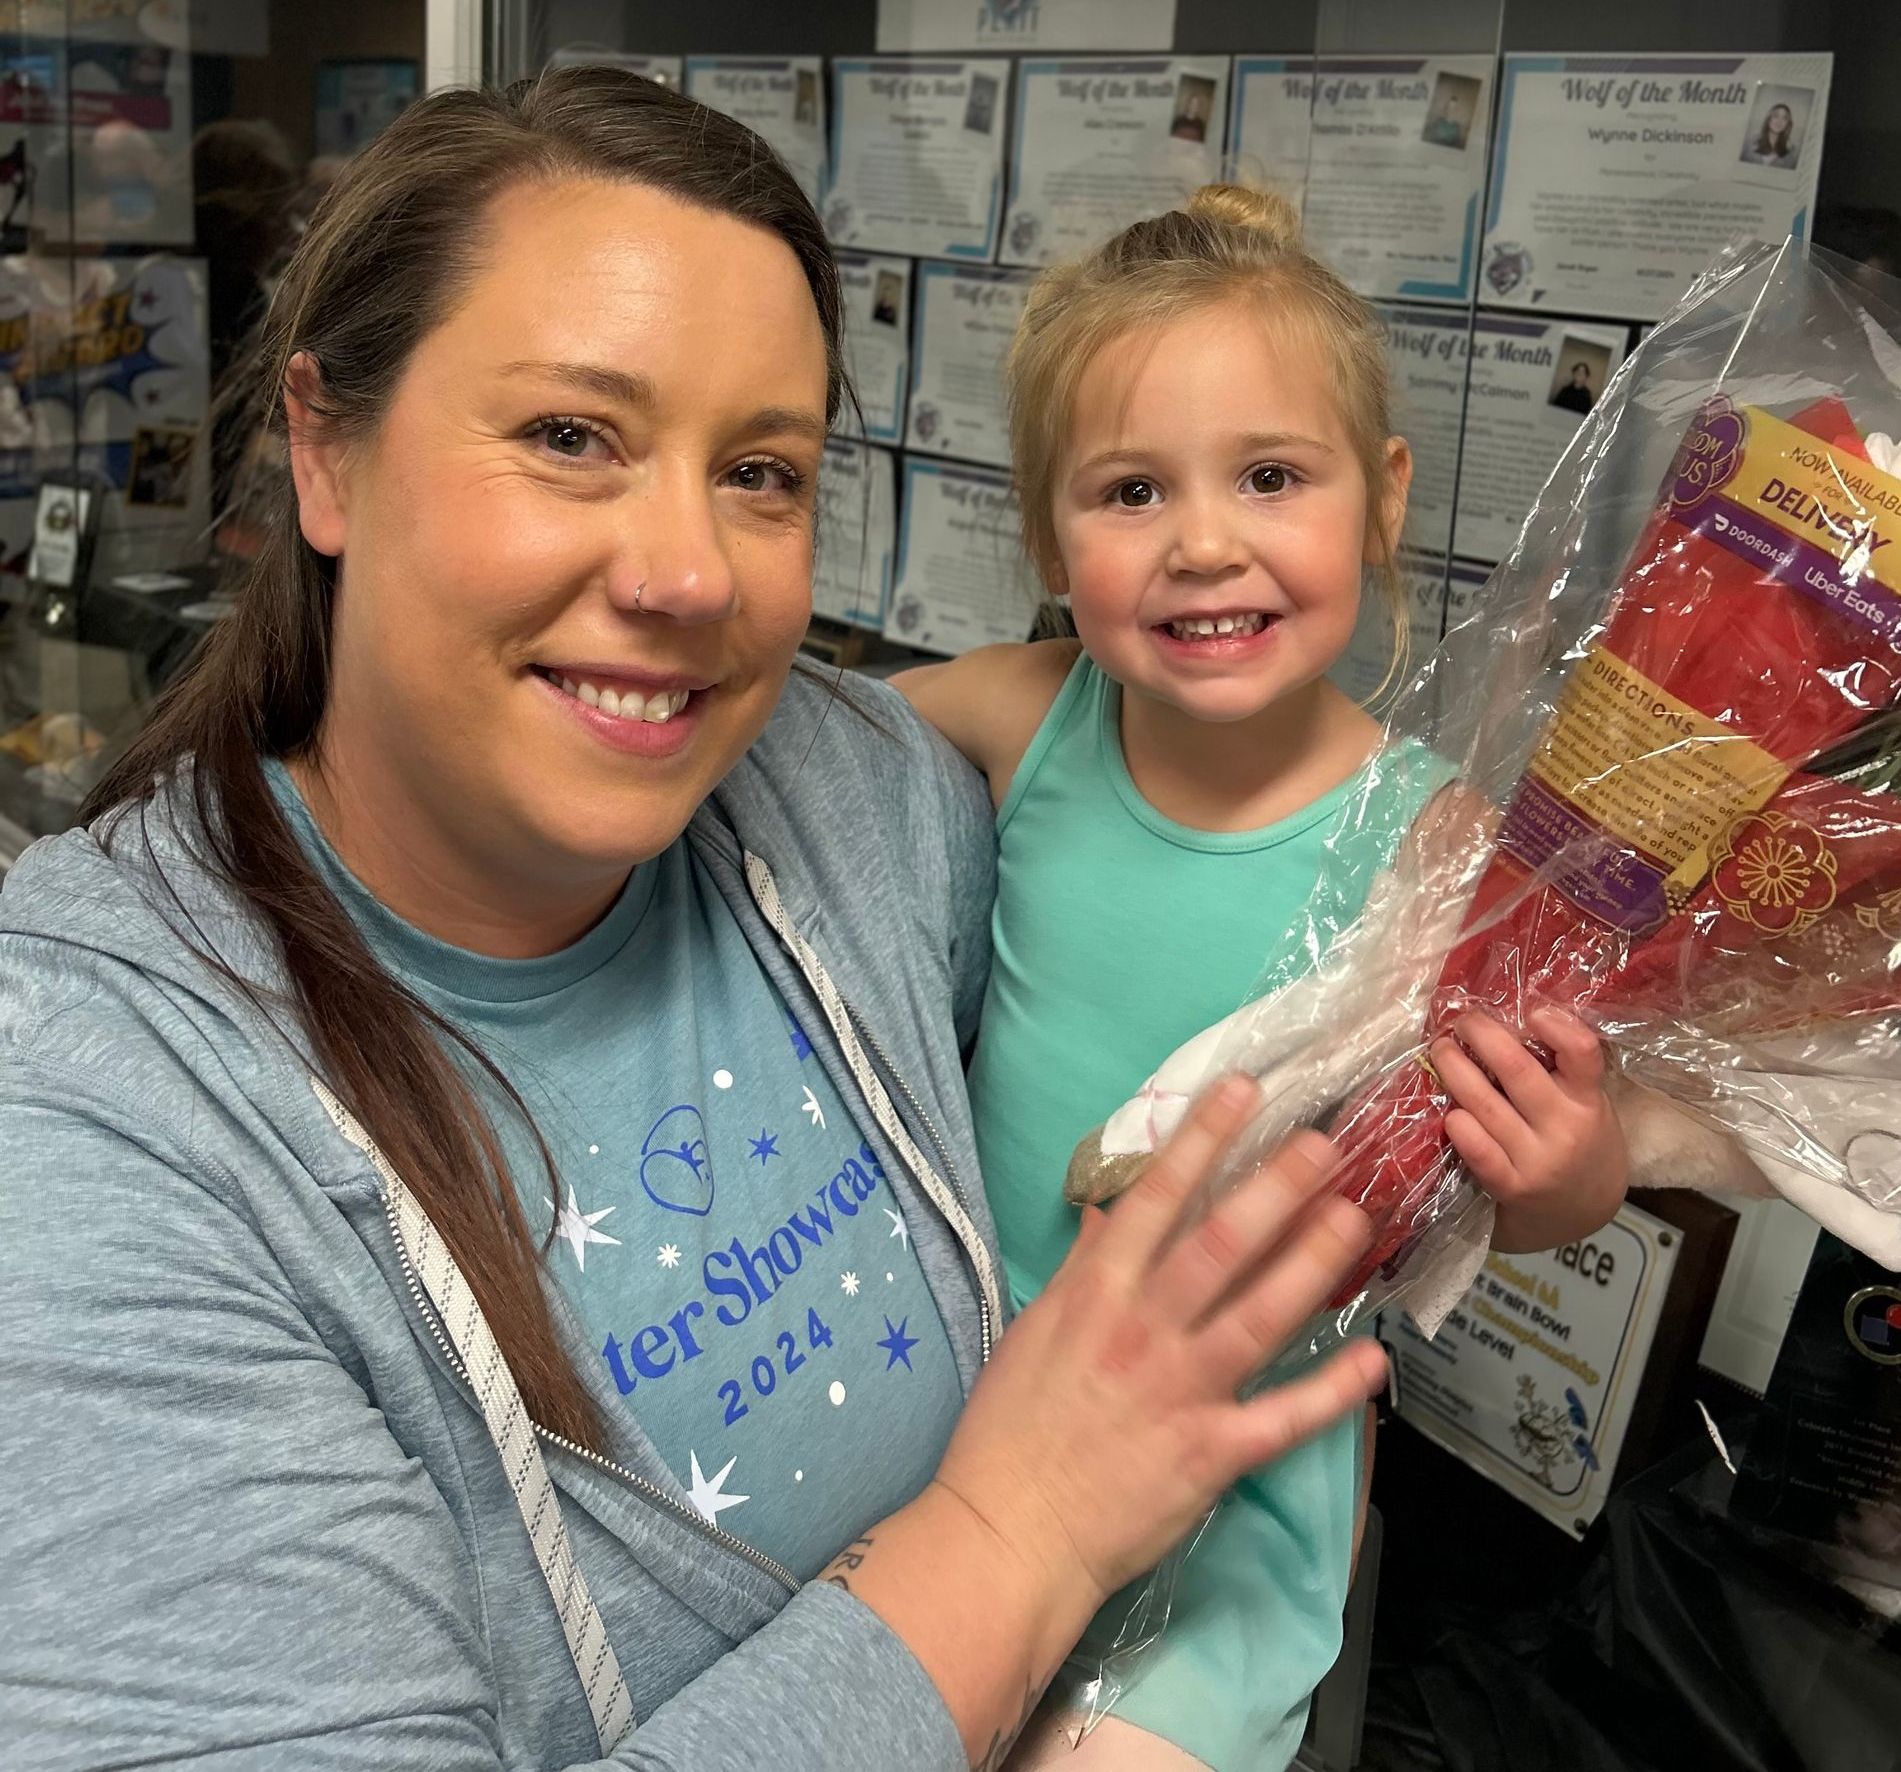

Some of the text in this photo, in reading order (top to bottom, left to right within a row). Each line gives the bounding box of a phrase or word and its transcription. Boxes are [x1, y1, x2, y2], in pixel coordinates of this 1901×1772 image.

[1560, 76, 1748, 109] Wolf of the Month
[1588, 127, 1714, 146] Wynne Dickinson
[1438, 333, 1460, 361] of
[1493, 339, 1552, 367] Month
[1789, 447, 1832, 475] NOW
[1728, 525, 1794, 568] DOORDASH
[1804, 566, 1886, 625] Uber Eats
[1591, 658, 1697, 738] DIRECTIONS
[1717, 802, 1735, 819] off
[1648, 835, 1666, 853] of
[1486, 1278, 1572, 1343] Brain Bowl
[1469, 1320, 1516, 1361] Level
[717, 1307, 835, 1427] 2024
